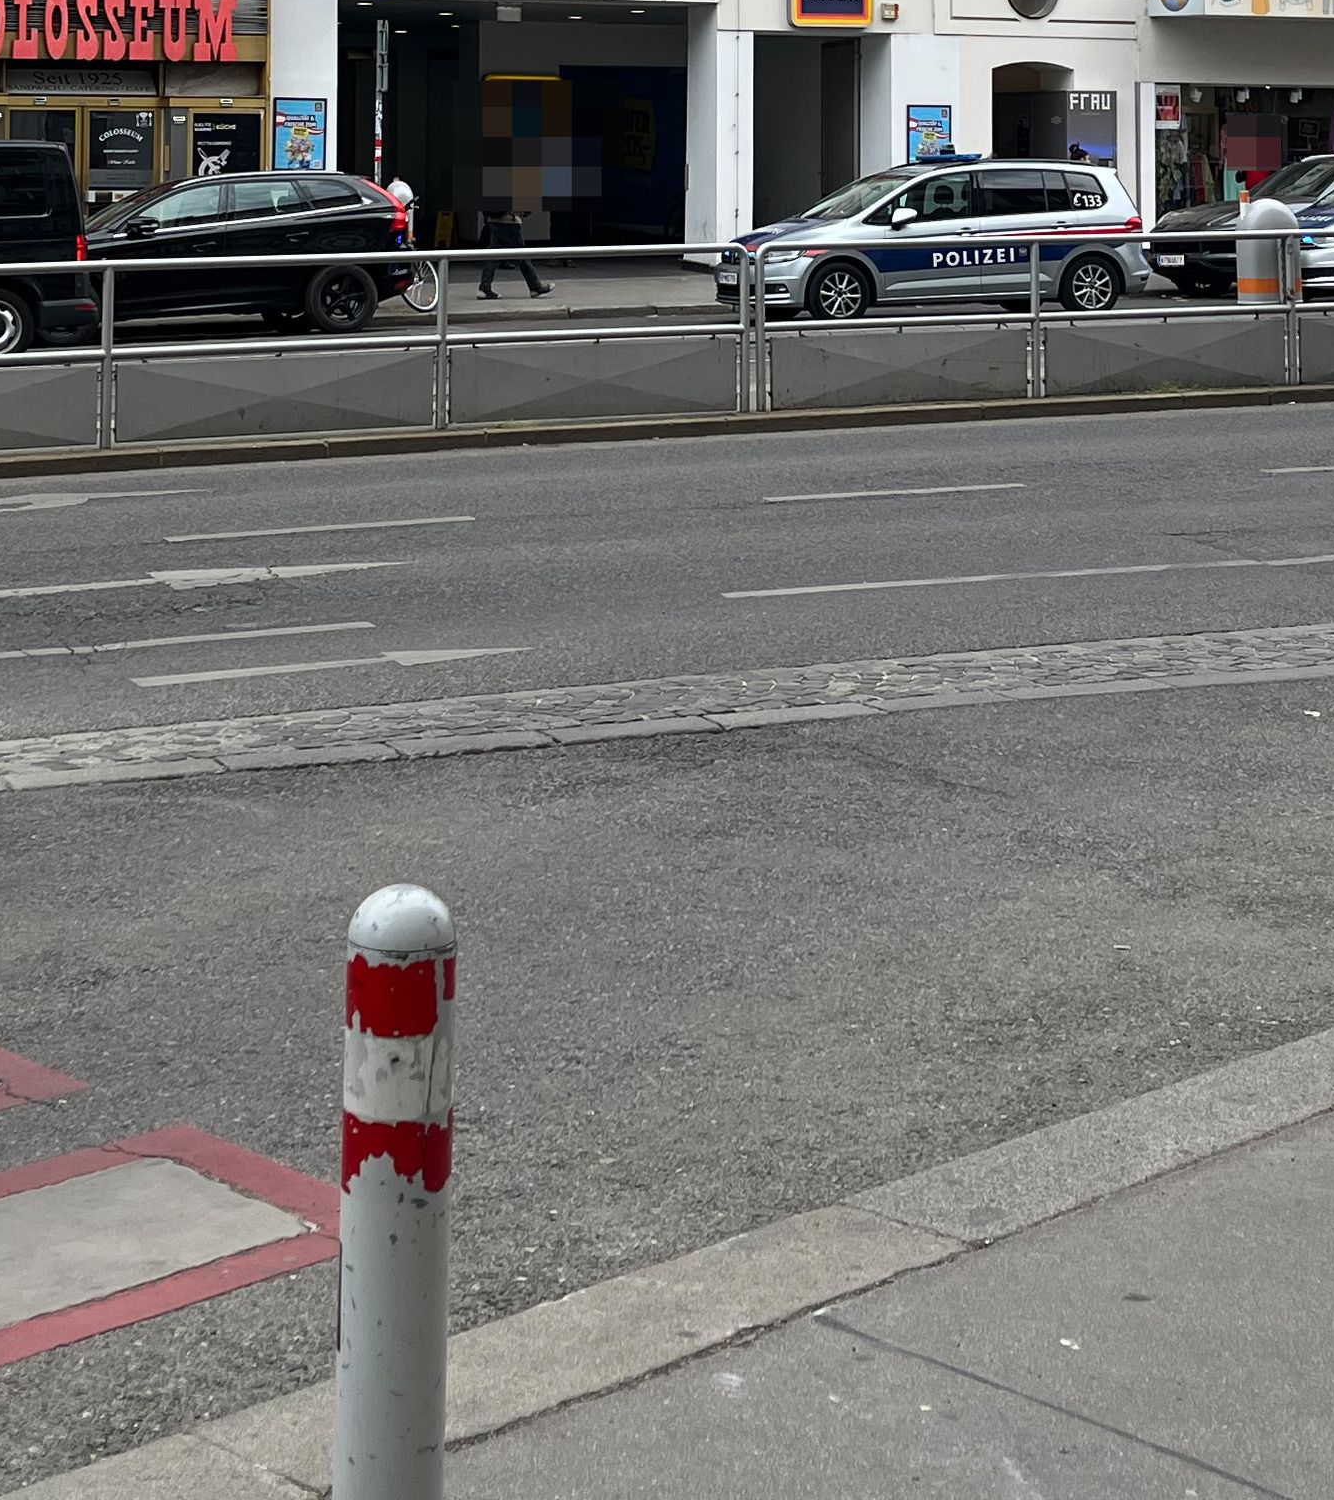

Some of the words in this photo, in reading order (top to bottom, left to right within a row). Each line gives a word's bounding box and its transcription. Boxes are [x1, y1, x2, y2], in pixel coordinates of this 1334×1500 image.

[33, 71, 70, 85] Seit
[79, 72, 123, 85] 1925
[98, 128, 144, 143] COLOSSEUM
[1082, 194, 1103, 207] 133
[932, 247, 1015, 267] POLIZEI
